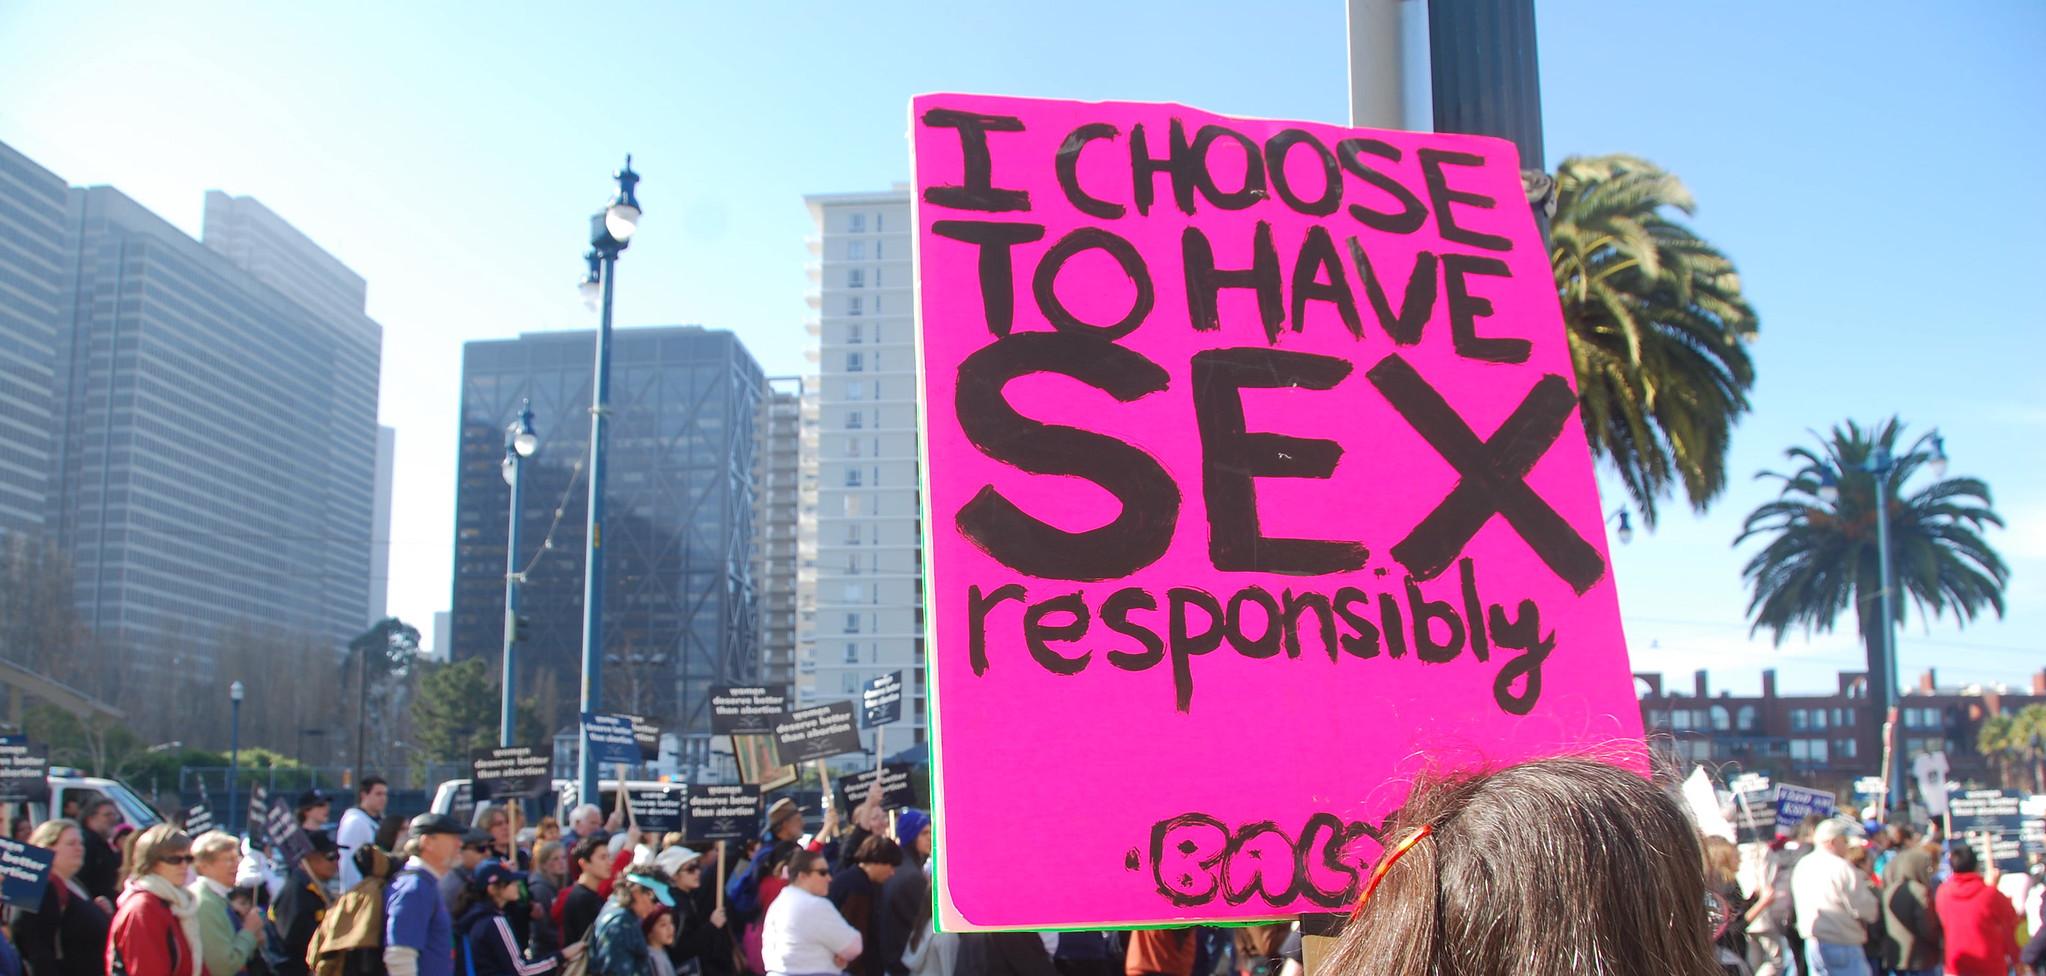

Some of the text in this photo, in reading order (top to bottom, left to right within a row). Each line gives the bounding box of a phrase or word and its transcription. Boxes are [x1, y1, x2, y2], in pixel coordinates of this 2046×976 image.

[922, 108, 1514, 252] I CHOOSE
[930, 218, 1532, 364] TO HAVE
[954, 331, 1607, 597] SEX
[966, 556, 1558, 716] responsibly
[711, 696, 785, 706] deserve better
[715, 705, 783, 715] than abortion
[792, 706, 832, 721] women
[775, 712, 852, 734] deserve better
[780, 723, 852, 744] than abortion
[474, 756, 551, 769] deserve better
[502, 766, 547, 777] abortion
[689, 796, 759, 807] deserve better
[716, 806, 756, 817] abortion
